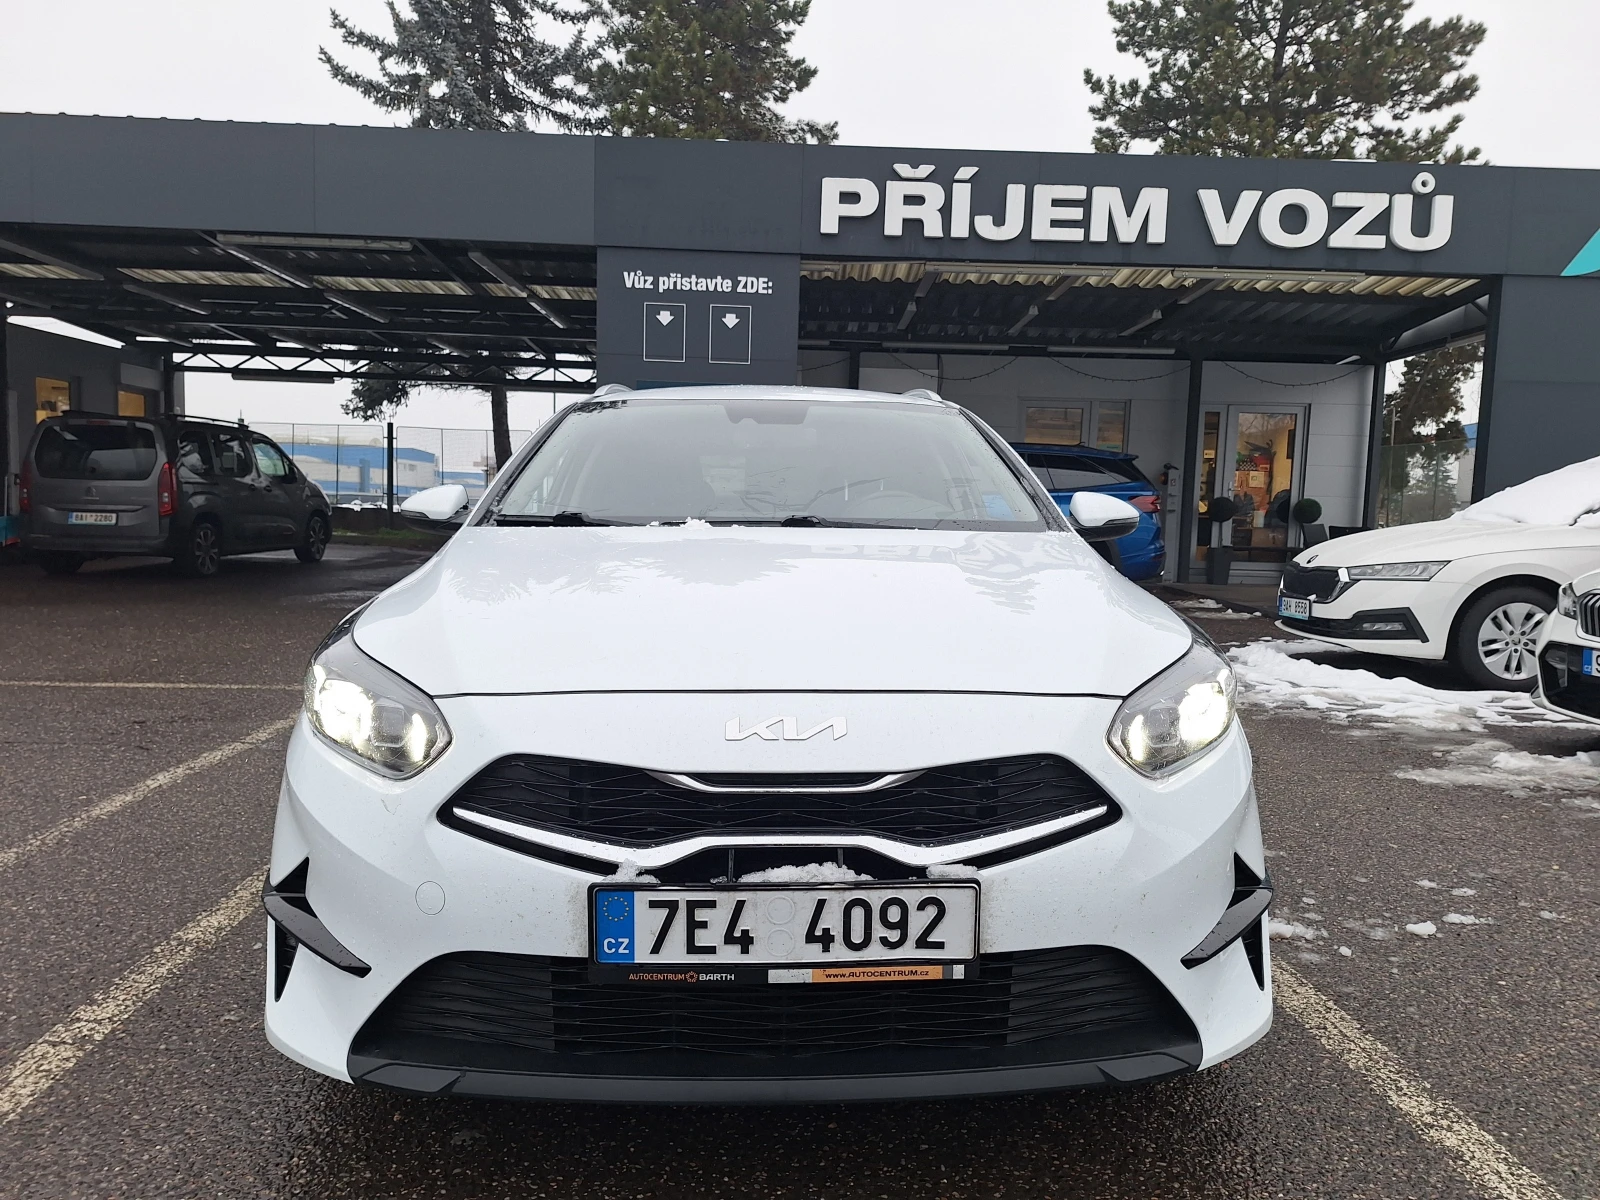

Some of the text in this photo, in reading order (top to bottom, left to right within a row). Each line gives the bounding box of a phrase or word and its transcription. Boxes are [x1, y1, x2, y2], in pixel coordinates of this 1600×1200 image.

[819, 163, 1455, 252] PŘÍJEM VOZŮ
[623, 270, 773, 294] Vůz přistavte ZDE:
[648, 896, 947, 955] 7E4 4092
[603, 937, 630, 954] CZ
[628, 973, 735, 981] AUTOCENTRUM BARTH
[825, 969, 930, 979] www.AUTOCENTRUM.cz
